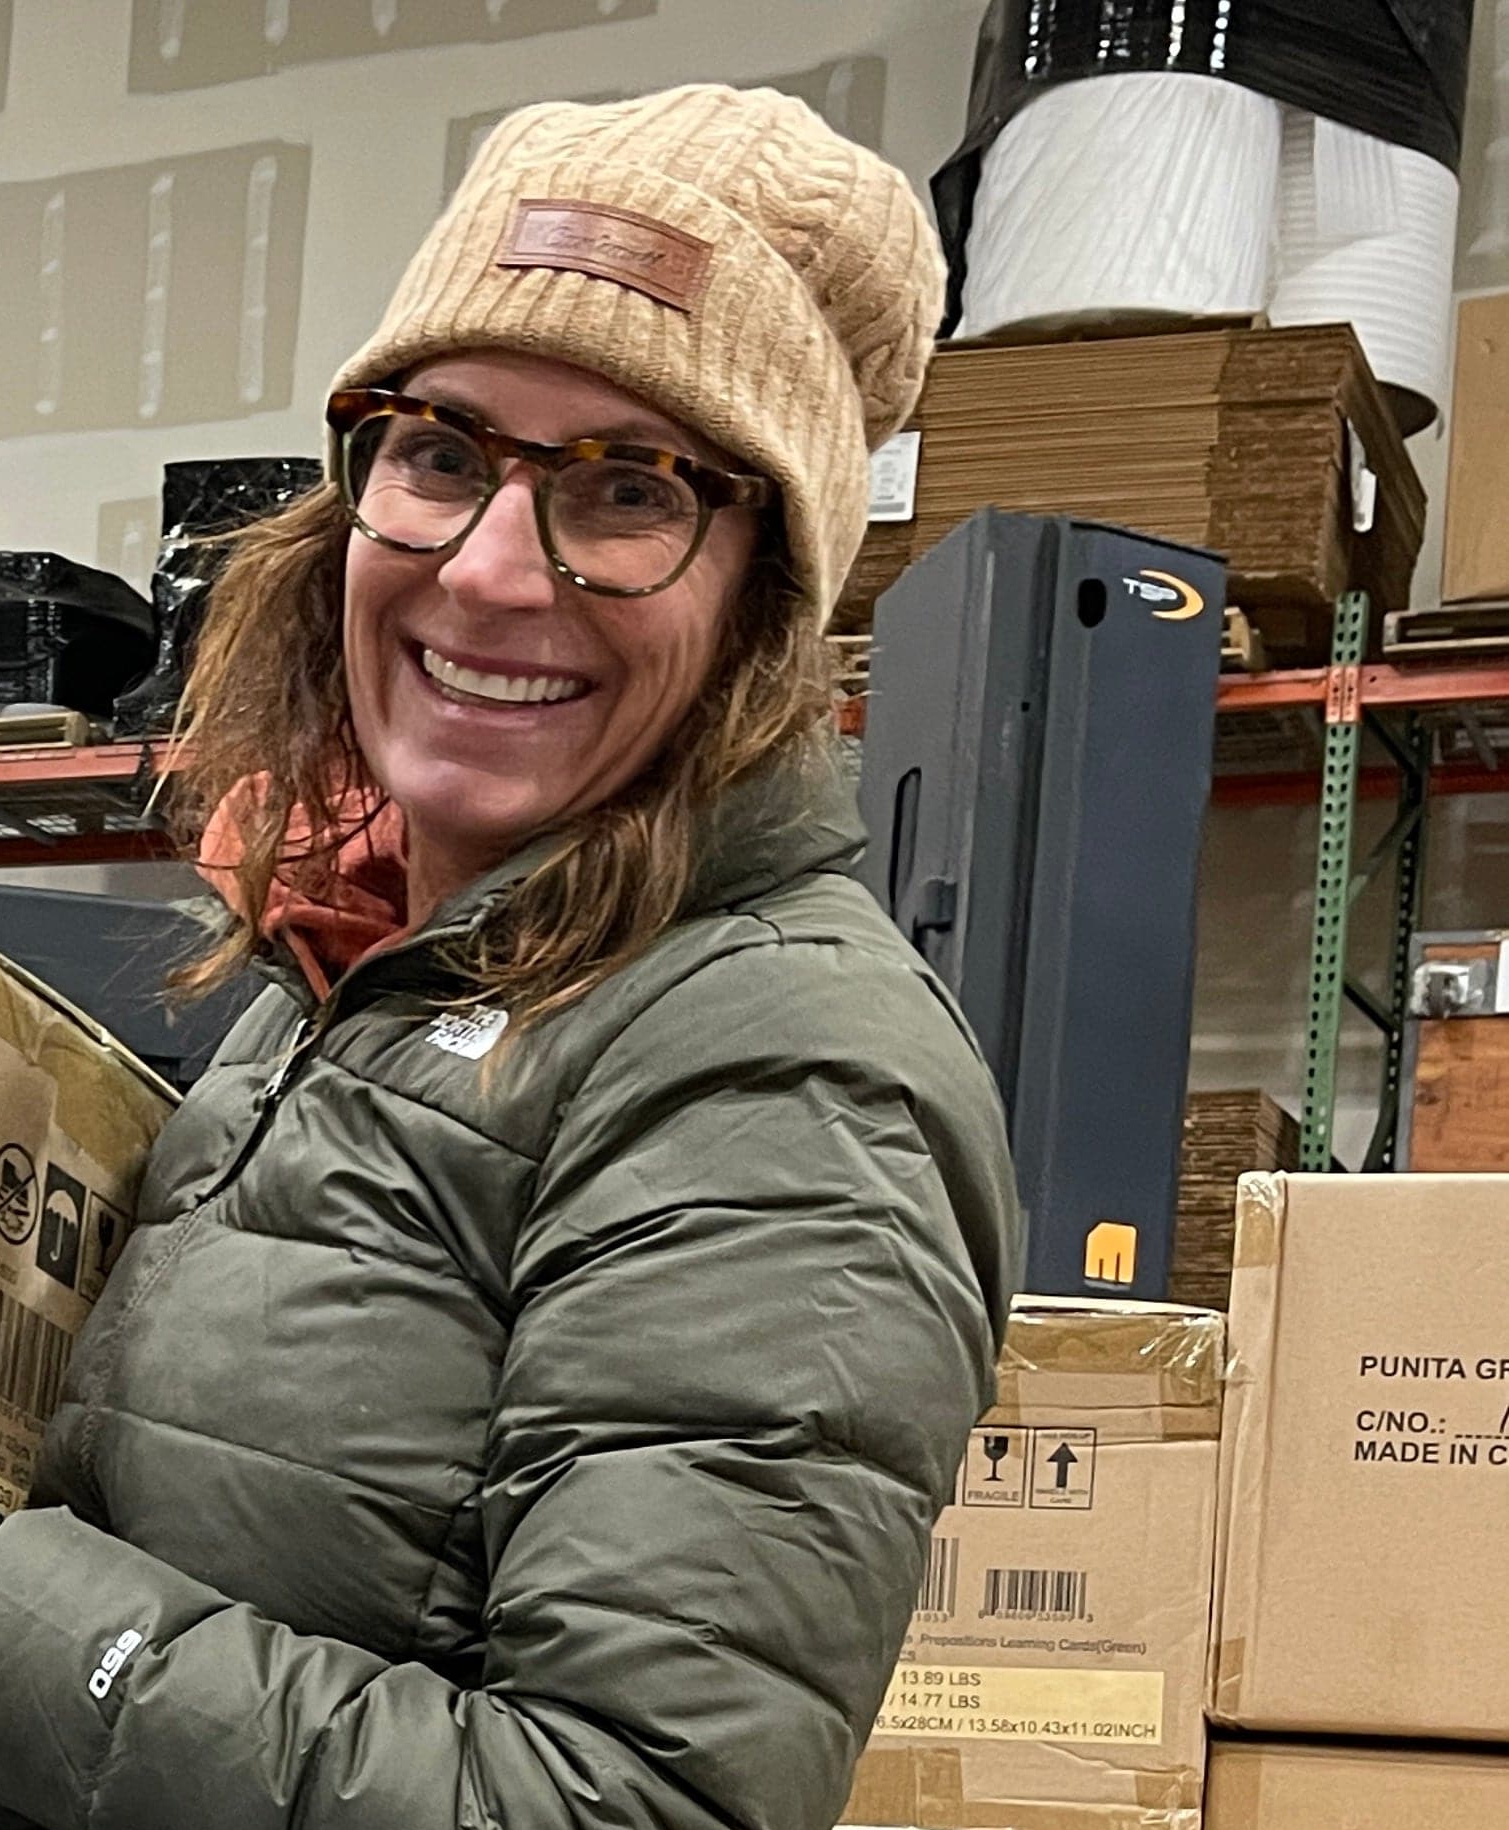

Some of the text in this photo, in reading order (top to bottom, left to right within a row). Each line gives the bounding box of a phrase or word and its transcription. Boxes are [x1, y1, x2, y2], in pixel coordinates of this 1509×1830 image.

[1359, 1355, 1467, 1379] PUNITA
[1356, 1409, 1447, 1434] C/NO.:
[1353, 1440, 1478, 1465] MADE IN
[967, 1489, 1020, 1502] FRAGILE
[948, 1672, 982, 1687] LBS
[948, 1695, 981, 1709] LBS
[876, 1714, 953, 1731] 6.5x28CM
